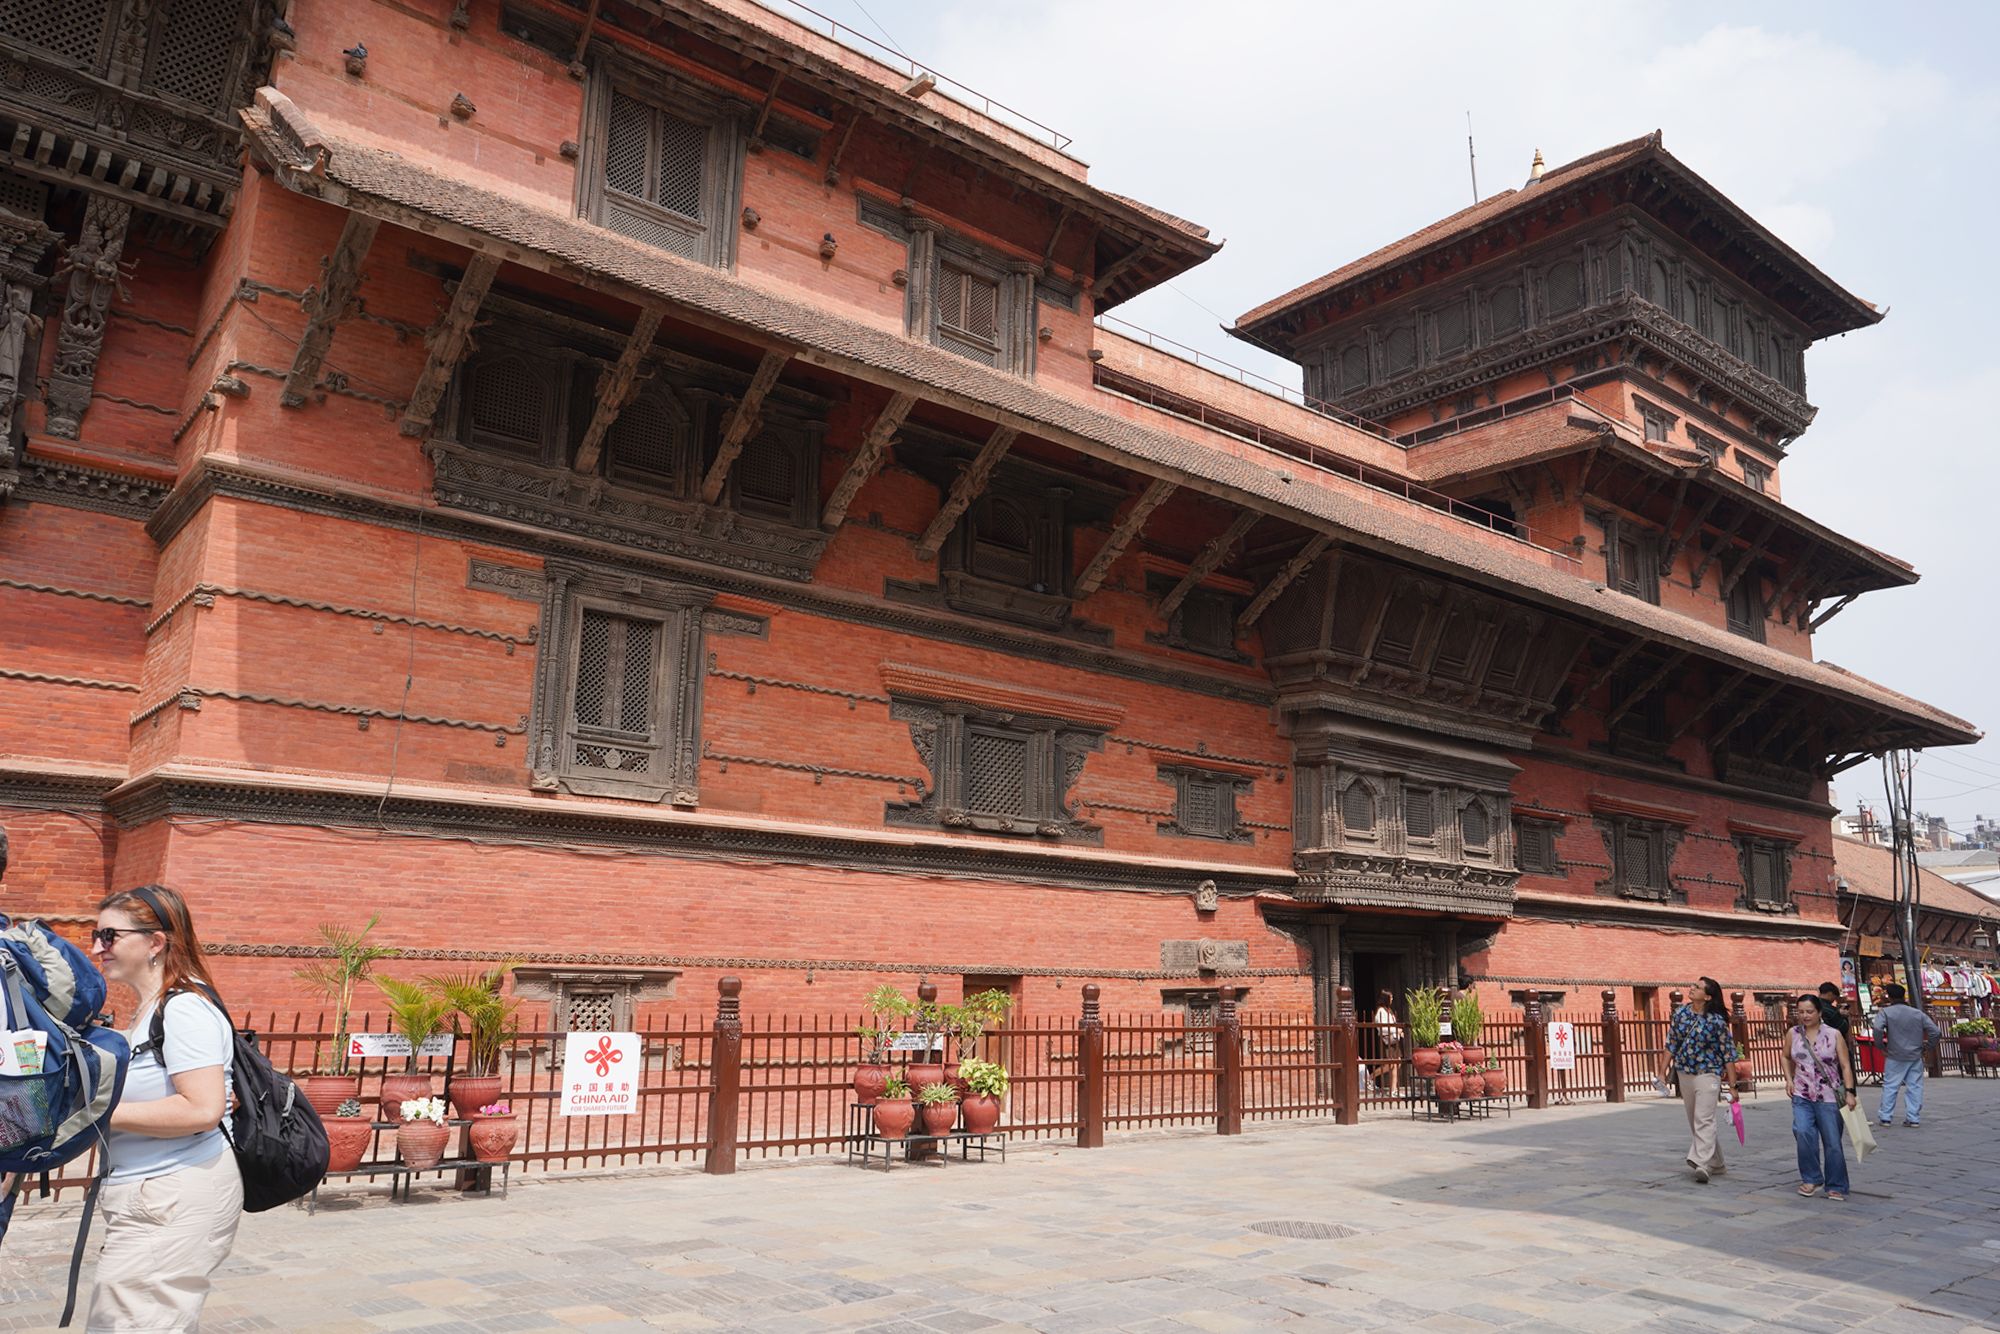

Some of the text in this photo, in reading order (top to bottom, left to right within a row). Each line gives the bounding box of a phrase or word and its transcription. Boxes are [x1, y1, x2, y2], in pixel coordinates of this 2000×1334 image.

[573, 1082, 629, 1092] 中国援助
[571, 1094, 629, 1104] CHINA AID
